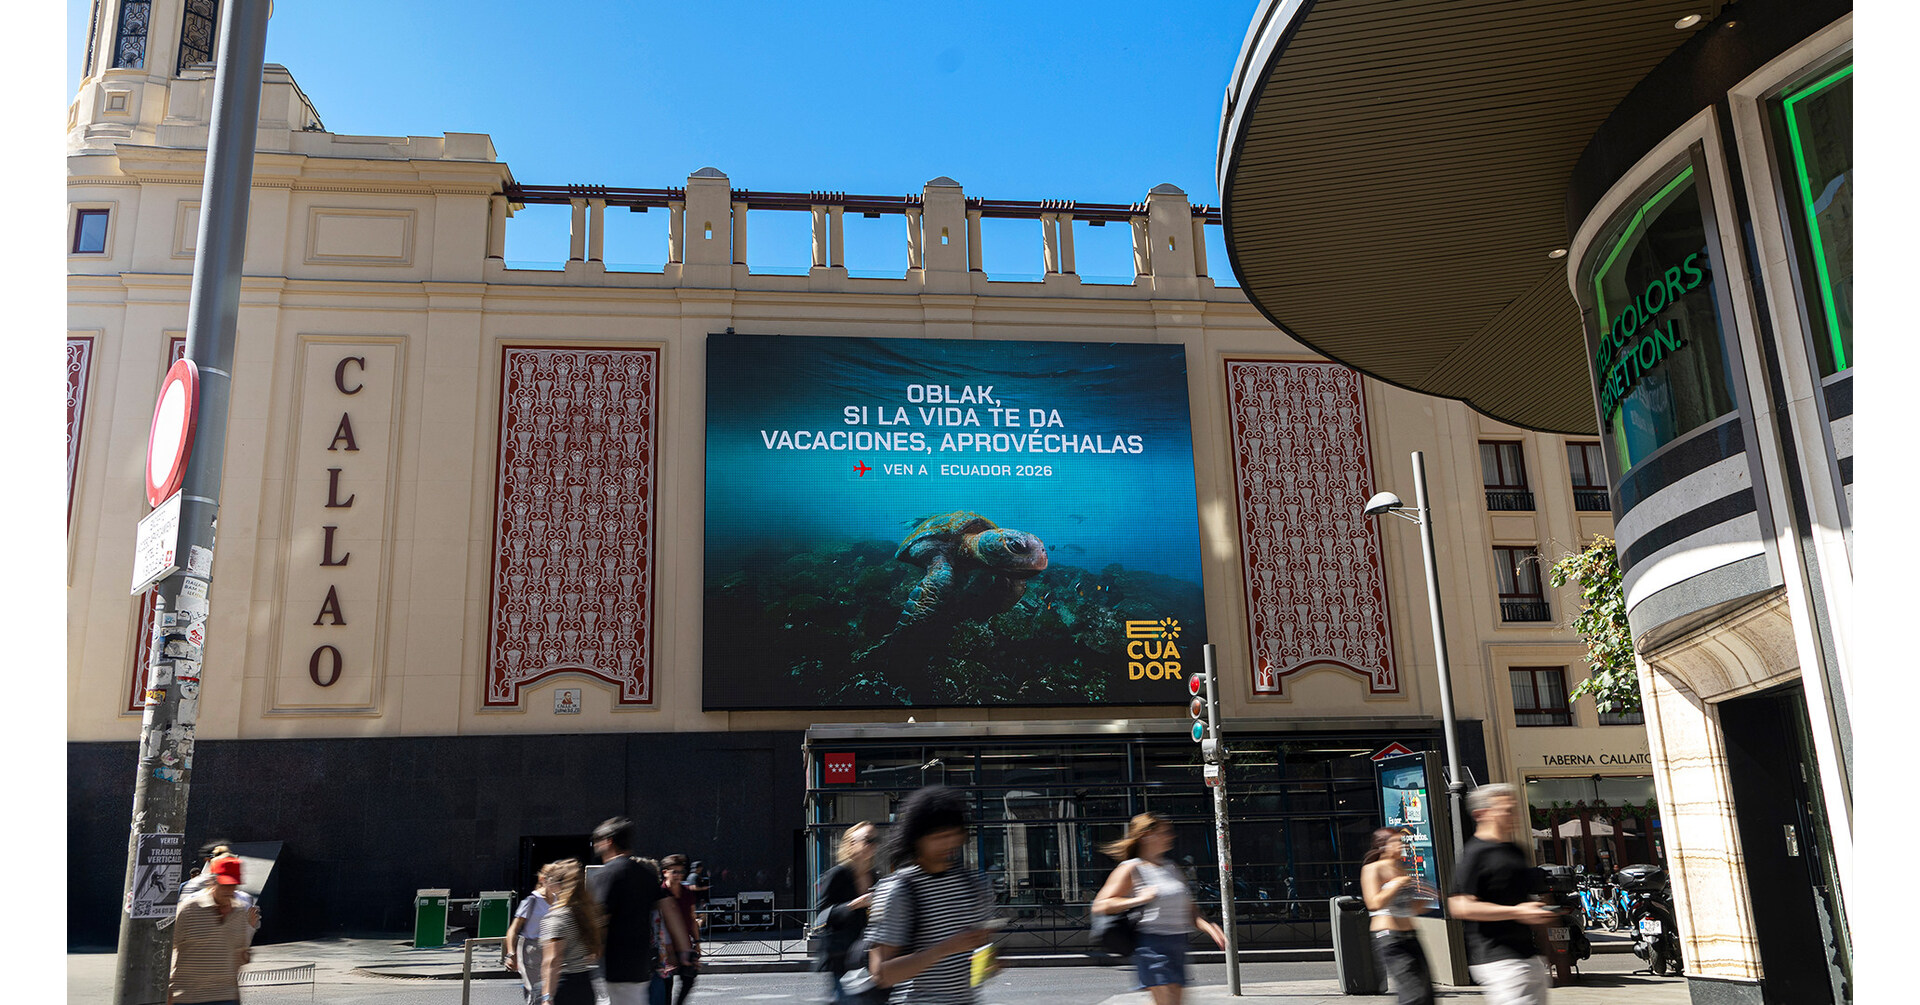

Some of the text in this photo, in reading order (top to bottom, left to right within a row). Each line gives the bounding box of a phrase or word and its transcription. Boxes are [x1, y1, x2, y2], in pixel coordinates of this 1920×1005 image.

[1612, 253, 1702, 348] COLORS
[1601, 319, 1682, 420] BENETTON.
[907, 384, 1001, 407] OBLAK,
[844, 405, 1065, 428] SI LA VIDA TE DA
[760, 429, 1144, 455] VACACIONES, APROVÉCHALAS
[883, 463, 1053, 477] VEN A ECUADOR 2026
[309, 357, 365, 688] CALLAO
[1127, 640, 1181, 660] CUA
[1128, 661, 1182, 680] DOR
[1542, 755, 1595, 765] TABERNA
